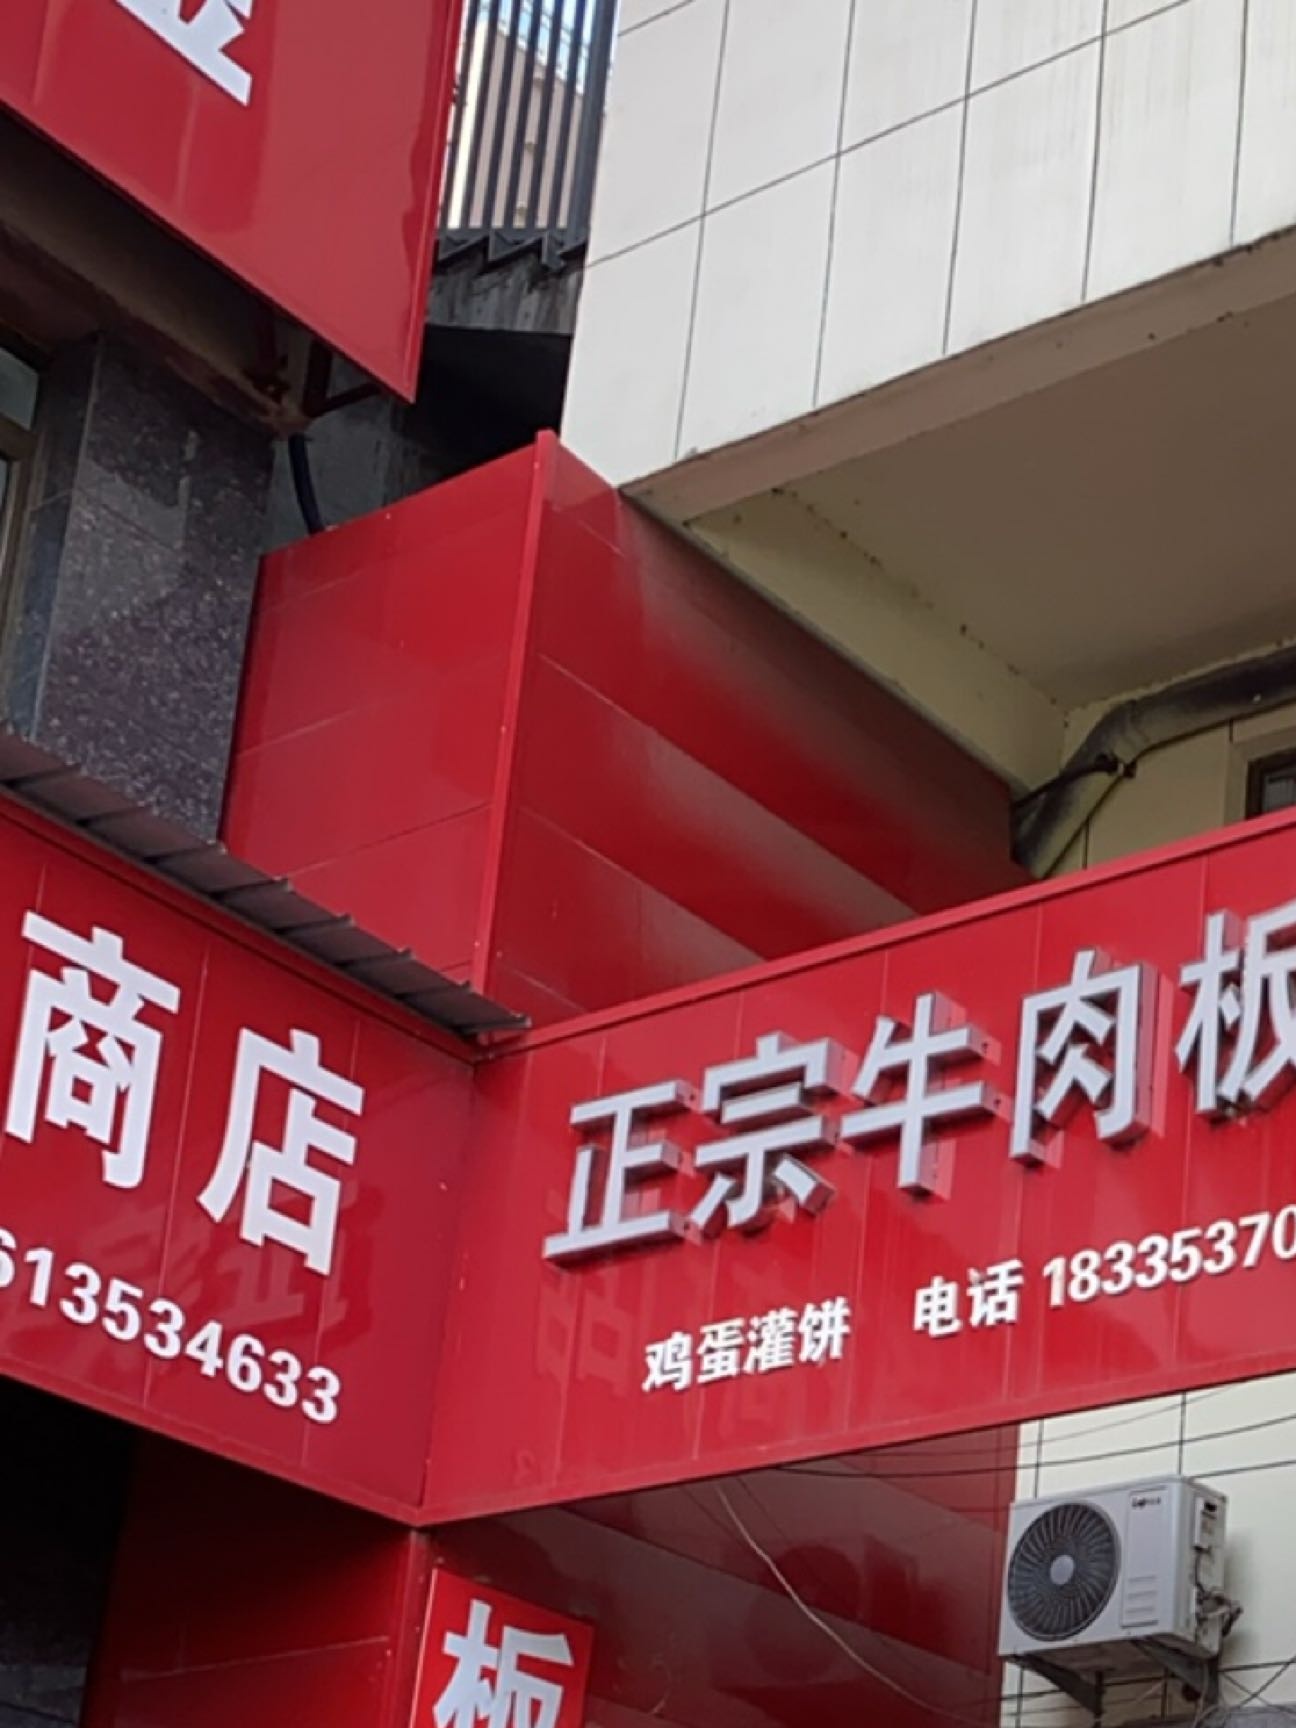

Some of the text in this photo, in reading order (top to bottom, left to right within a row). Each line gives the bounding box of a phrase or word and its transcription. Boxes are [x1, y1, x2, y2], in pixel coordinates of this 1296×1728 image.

[4, 910, 366, 1277] 商店
[642, 1296, 851, 1392] 鸡蛋灌饼
[914, 1258, 1024, 1339] 电话
